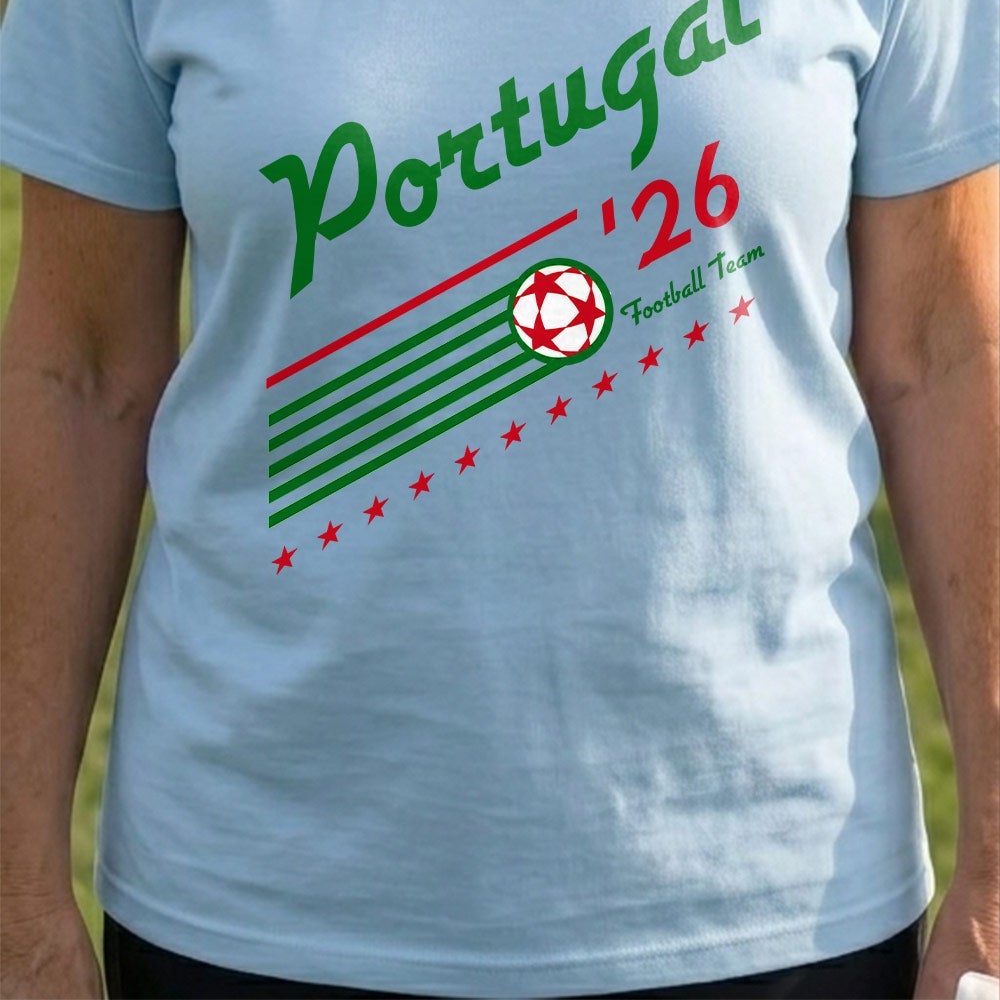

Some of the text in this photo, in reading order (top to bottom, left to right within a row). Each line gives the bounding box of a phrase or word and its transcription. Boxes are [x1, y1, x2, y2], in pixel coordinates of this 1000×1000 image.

[601, 140, 740, 270] '26
[619, 245, 765, 326] Football Team
